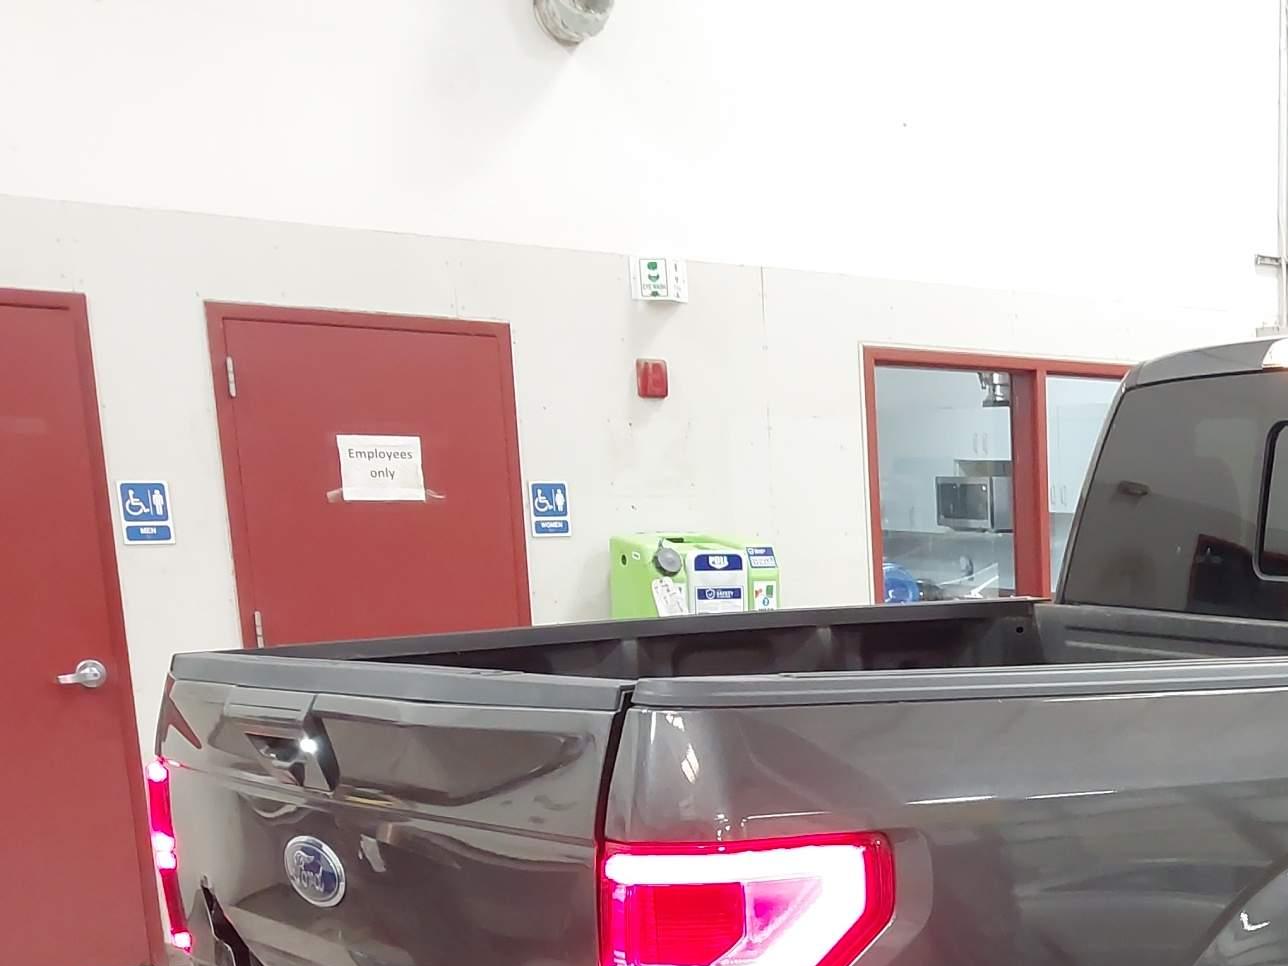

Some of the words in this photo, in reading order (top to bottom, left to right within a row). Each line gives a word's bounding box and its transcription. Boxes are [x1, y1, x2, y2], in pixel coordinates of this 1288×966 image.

[347, 448, 413, 461] Employees
[370, 467, 395, 480] only
[139, 527, 157, 535] MEN
[541, 521, 564, 529] WOMEN
[290, 850, 325, 893] Ford
